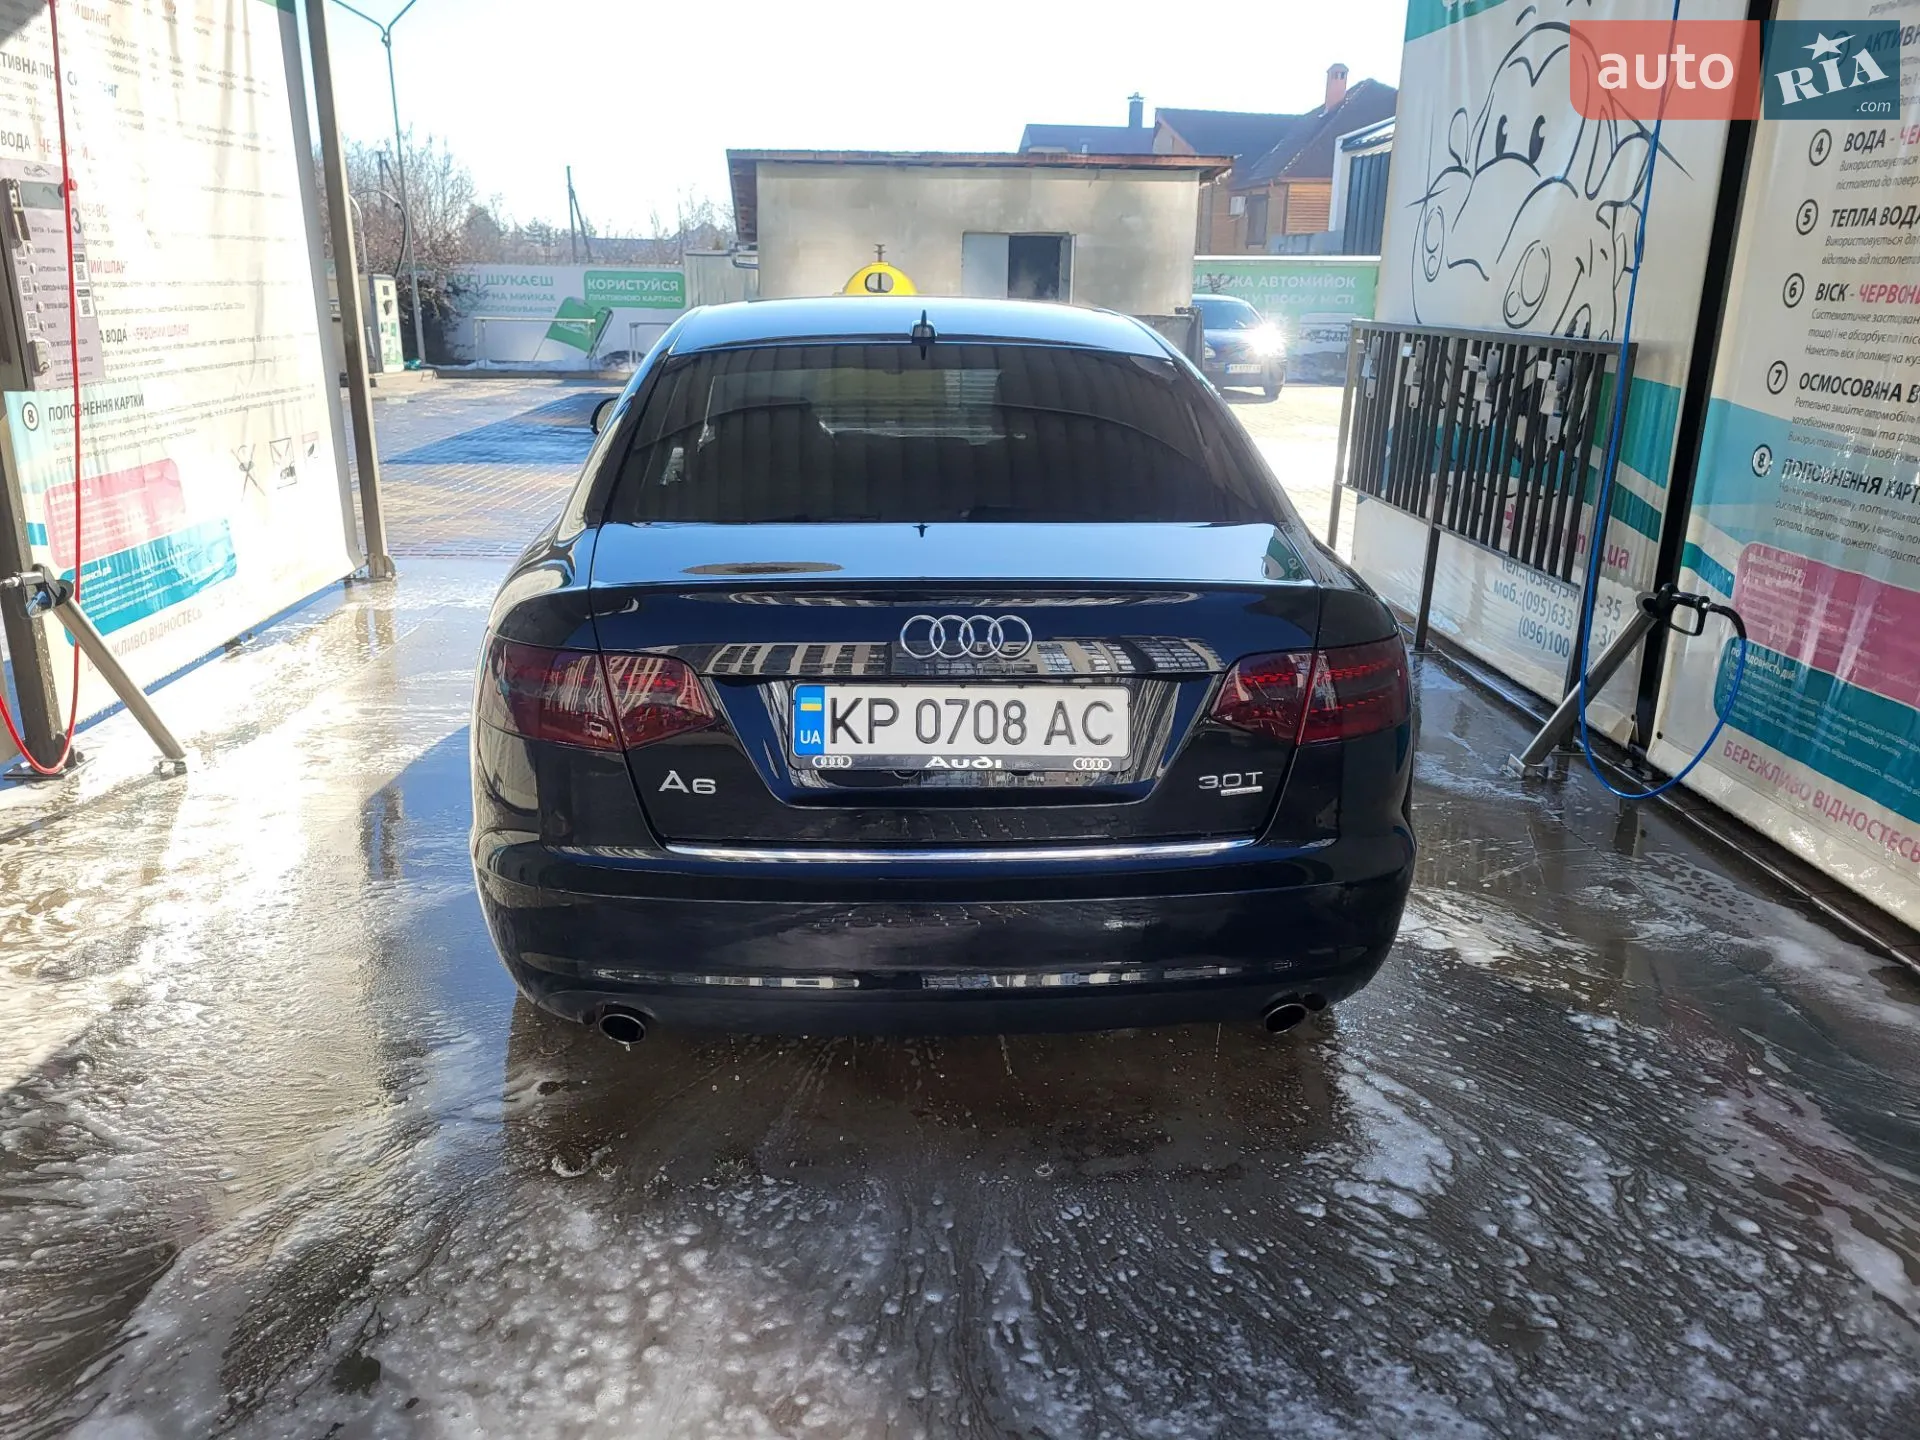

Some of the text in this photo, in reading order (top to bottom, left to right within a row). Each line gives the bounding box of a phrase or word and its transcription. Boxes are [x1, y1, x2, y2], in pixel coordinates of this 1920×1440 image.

[0, 50, 38, 75] ТИВНА
[1843, 128, 1886, 154] ВОДА
[1830, 206, 1878, 228] ТЕПЛА
[587, 278, 679, 293] КОРИСТУЙСЯ
[1257, 273, 1356, 289] АВТОМИЙОК
[1815, 283, 1850, 302] ВІСК
[1800, 371, 1902, 403] ОСМОСОВАНА
[829, 697, 1114, 746] KP 0708 AC
[800, 730, 822, 745] UA
[924, 756, 1002, 770] Audi
[1723, 739, 1812, 803] БЕРЕЖЛИВО
[658, 769, 717, 795] A6
